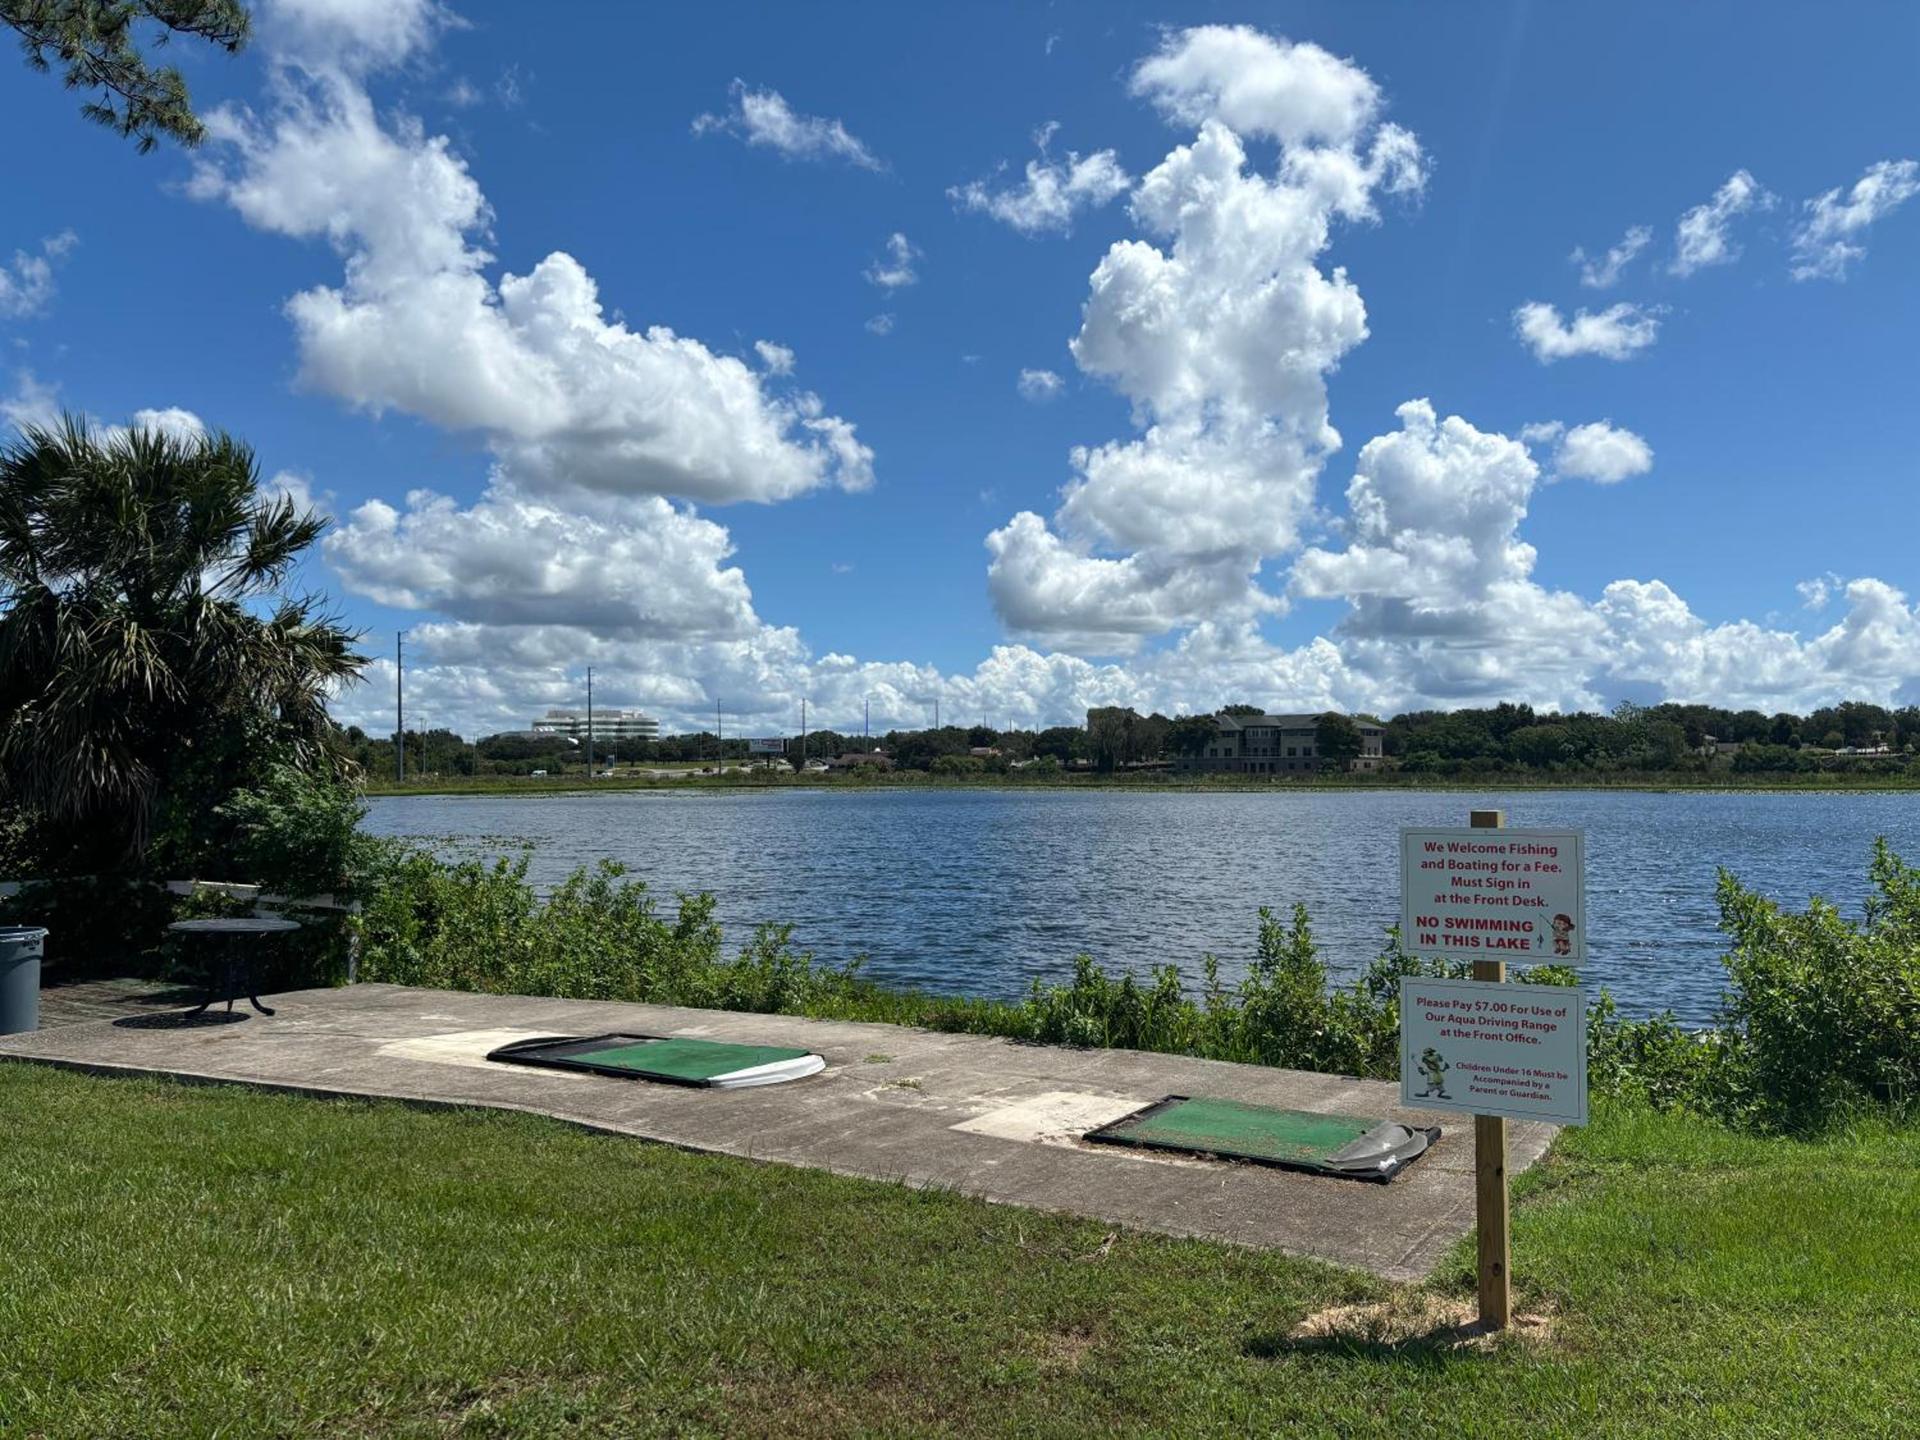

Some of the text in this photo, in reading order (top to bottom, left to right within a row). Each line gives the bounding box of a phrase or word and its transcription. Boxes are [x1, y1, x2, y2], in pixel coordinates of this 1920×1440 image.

[1424, 842, 1558, 857] We Welcome Fishing
[1421, 859, 1444, 869] and
[1448, 860, 1498, 873] Boating
[1502, 860, 1519, 871] for
[1535, 861, 1562, 872] Fee.
[1451, 877, 1530, 890] Must Sign in
[1434, 894, 1549, 907] at the Front Desk.
[1416, 916, 1534, 932] NO SWIMMING
[1420, 934, 1530, 949] IN THIS LAKE
[1416, 997, 1566, 1017] Please Pay $7.00 For Use of
[1425, 1012, 1557, 1032] Our Aqua Driving Range
[1440, 1028, 1541, 1044] at the Front Office.
[1456, 1062, 1568, 1080] Children Under 16 Must be
[1473, 1075, 1530, 1088] Accompanied
[1532, 1080, 1543, 1089] by
[1469, 1085, 1497, 1095] Parent
[1510, 1089, 1552, 1100] Guardian.
